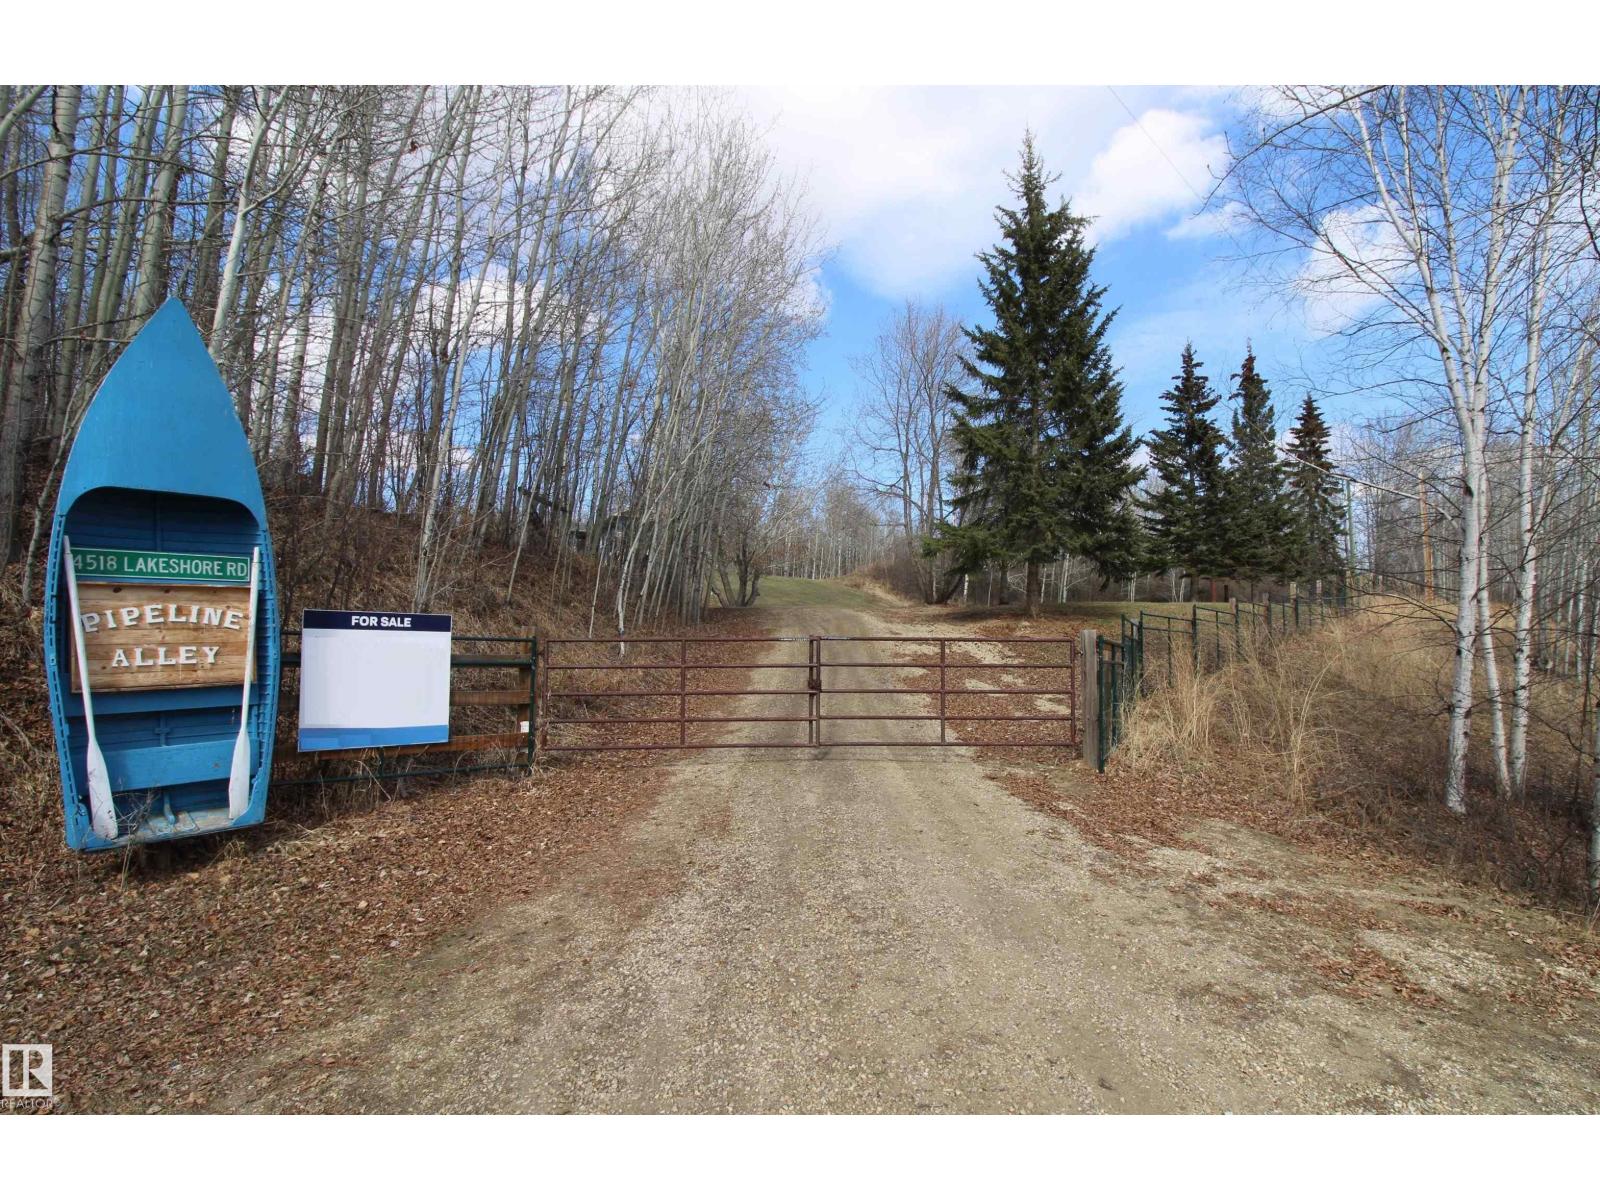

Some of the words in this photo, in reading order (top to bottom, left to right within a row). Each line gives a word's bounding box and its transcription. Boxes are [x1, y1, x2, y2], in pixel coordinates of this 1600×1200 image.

[73, 554, 117, 571] 4518
[124, 557, 223, 576] LAKESHORE
[226, 562, 248, 577] RD
[80, 604, 244, 633] PIPELINE
[351, 615, 379, 627] FOR
[380, 616, 412, 628] SALE
[112, 646, 220, 667] ALLEY
